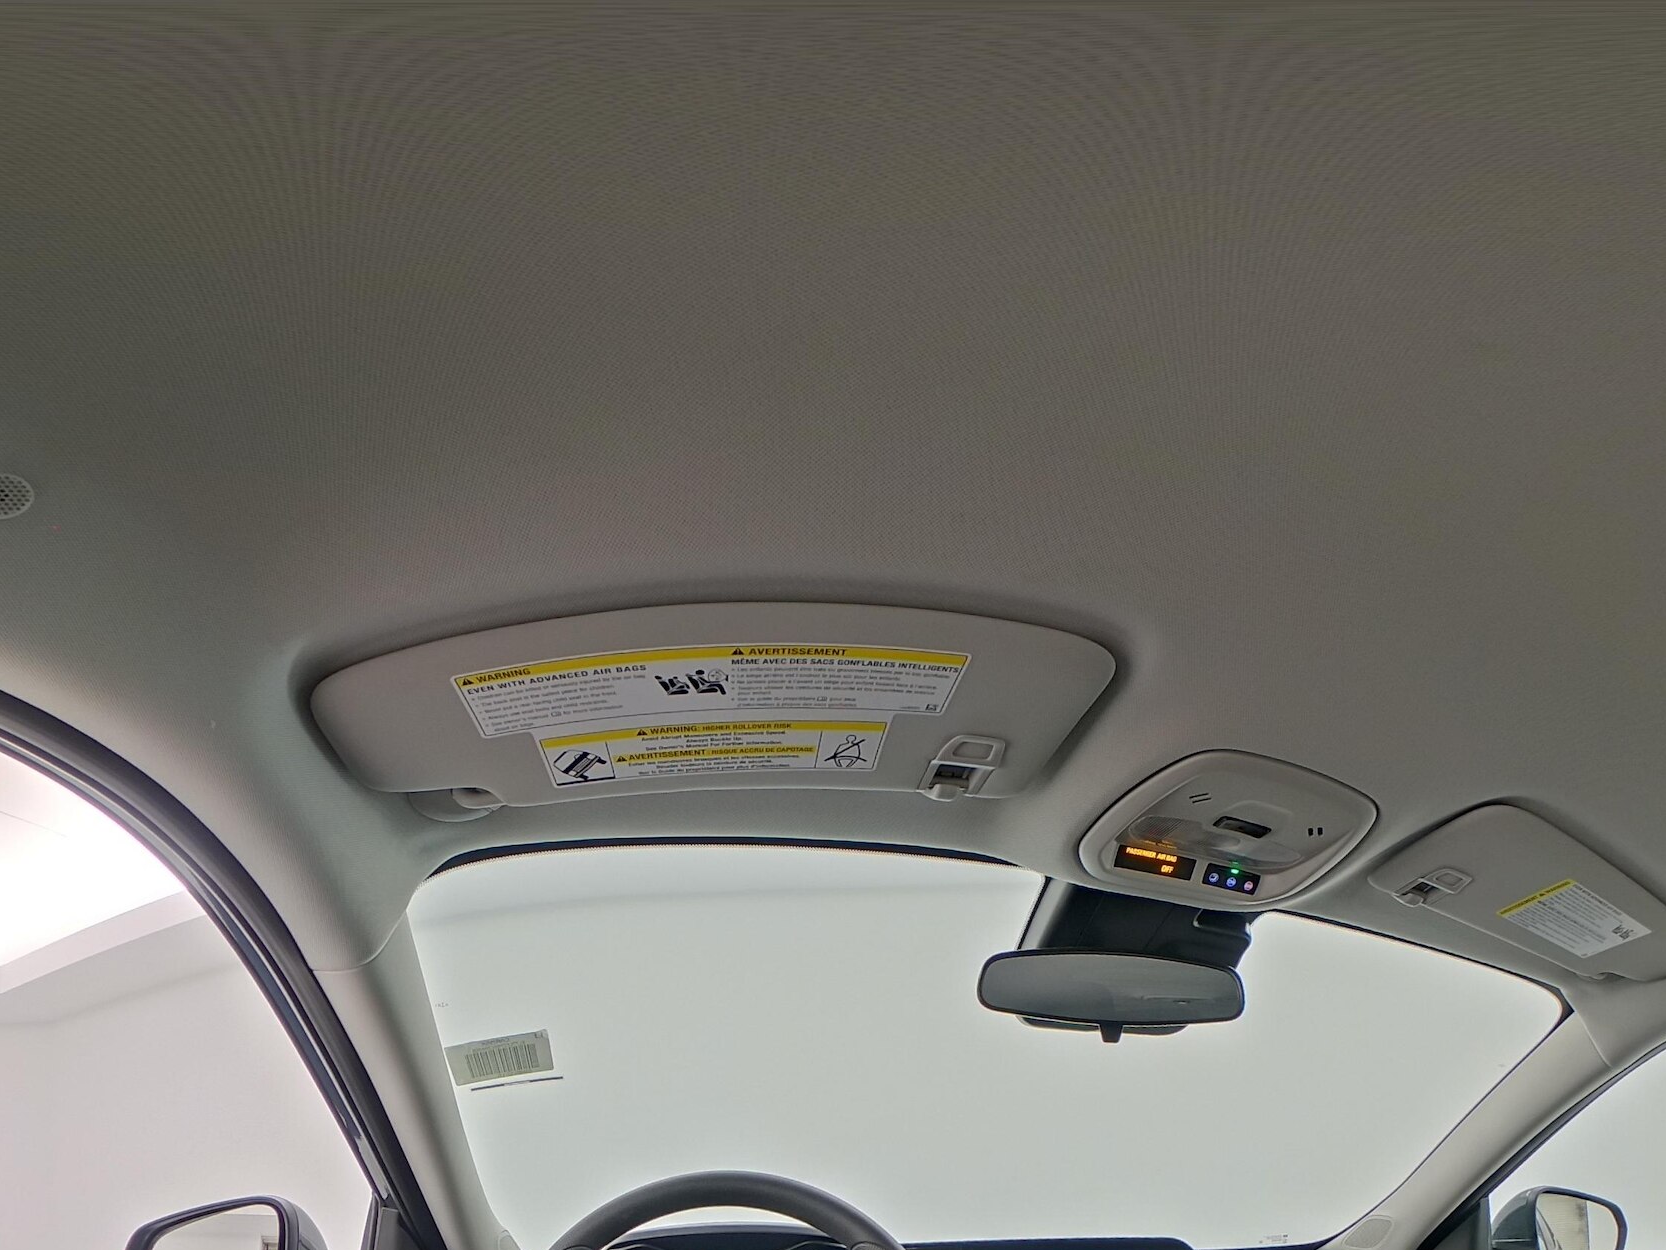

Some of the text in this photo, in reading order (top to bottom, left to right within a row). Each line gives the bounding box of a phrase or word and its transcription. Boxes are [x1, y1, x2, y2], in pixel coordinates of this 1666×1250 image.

[748, 648, 847, 656] AVERTISSEMENT
[837, 660, 896, 668] GONFLABLES
[898, 661, 959, 673] INTELLIGENTS
[467, 686, 495, 695] EVEN
[497, 680, 525, 689] WITH
[529, 670, 589, 684] ADVANCED
[616, 665, 647, 673] BAGS
[476, 668, 531, 683] WARNING
[628, 749, 705, 761] AVERTISSEMENT
[1126, 847, 1157, 859] PASSENGER
[1161, 865, 1174, 874] OFF
